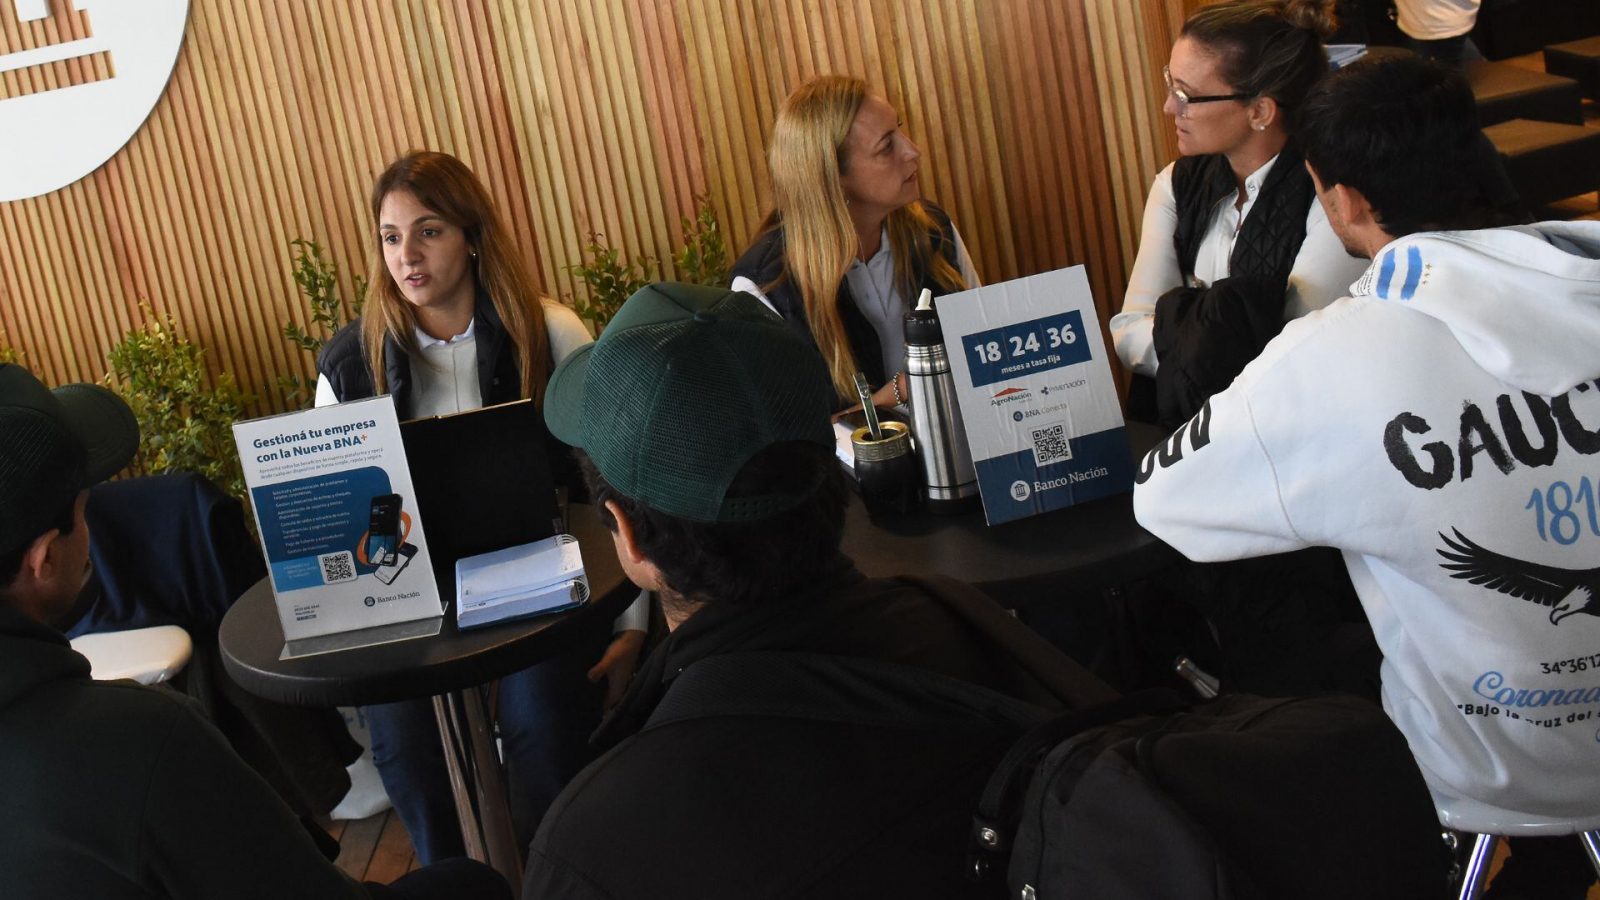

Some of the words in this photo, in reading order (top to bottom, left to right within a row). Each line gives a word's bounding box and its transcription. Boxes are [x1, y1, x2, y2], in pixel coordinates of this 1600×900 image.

[974, 341, 1002, 364] 18
[1009, 332, 1040, 357] 24
[1046, 323, 1076, 348] 36
[1001, 363, 1025, 374] meses
[1031, 357, 1047, 367] tasa
[1047, 354, 1061, 364] fija
[991, 392, 1032, 406] AgroNación
[1025, 409, 1040, 418] BNA
[253, 430, 308, 448] Gestioná
[309, 429, 322, 438] tu
[324, 419, 376, 435] empresa
[1384, 377, 1600, 490] GAUC
[256, 453, 278, 463] con
[280, 448, 291, 458] la
[293, 441, 332, 456] Nueva
[1033, 477, 1067, 492] Banco
[1068, 466, 1109, 484] Nación
[1525, 475, 1600, 545] 181
[377, 595, 397, 603] Banco
[398, 591, 421, 600] Nación
[1506, 709, 1519, 719] la
[1525, 717, 1562, 728] ruz
[1566, 710, 1592, 723] del
